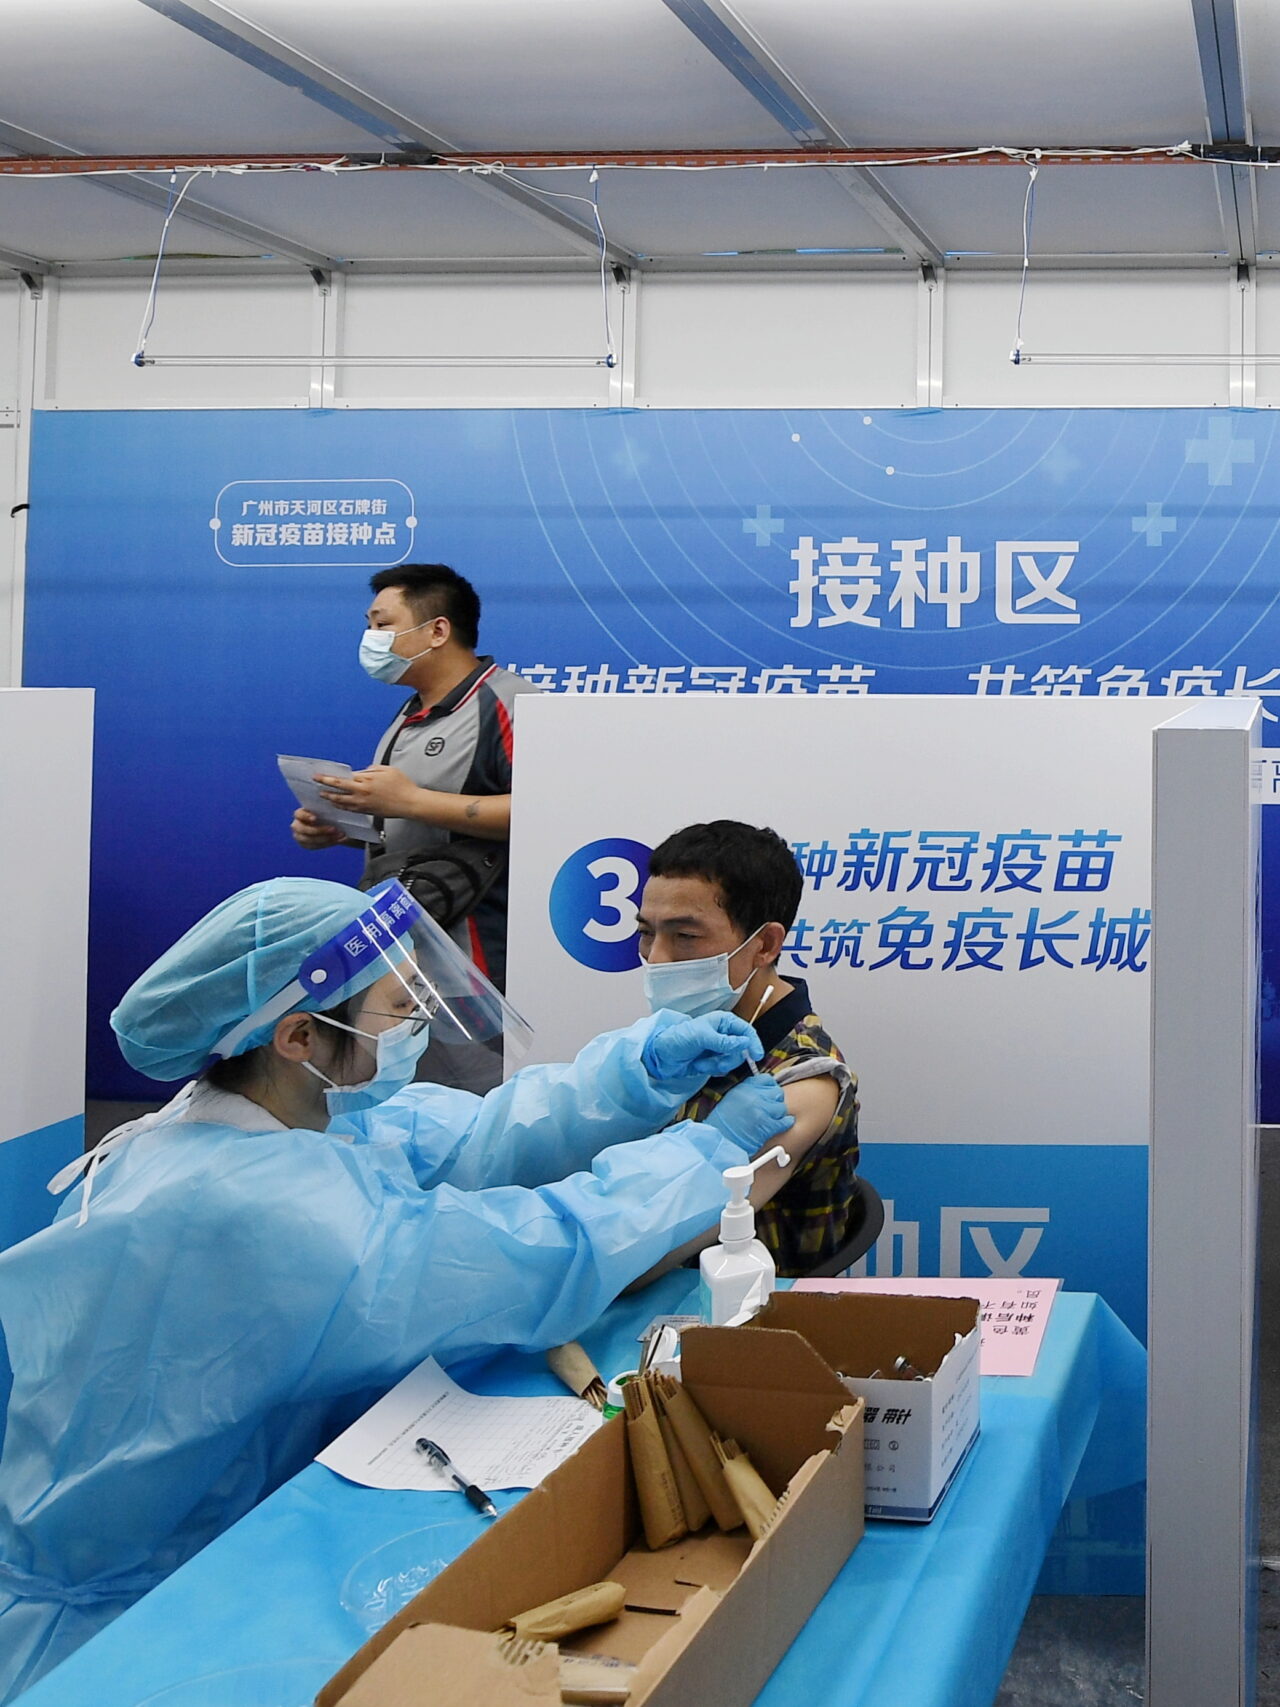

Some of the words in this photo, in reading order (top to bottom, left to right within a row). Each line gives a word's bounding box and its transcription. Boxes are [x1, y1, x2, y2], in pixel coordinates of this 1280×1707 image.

[231, 522, 397, 547] 新冠疫苗接种点
[241, 499, 388, 517] 广州市天河区石牌街
[789, 536, 1081, 629] 接种区
[582, 856, 640, 943] 3
